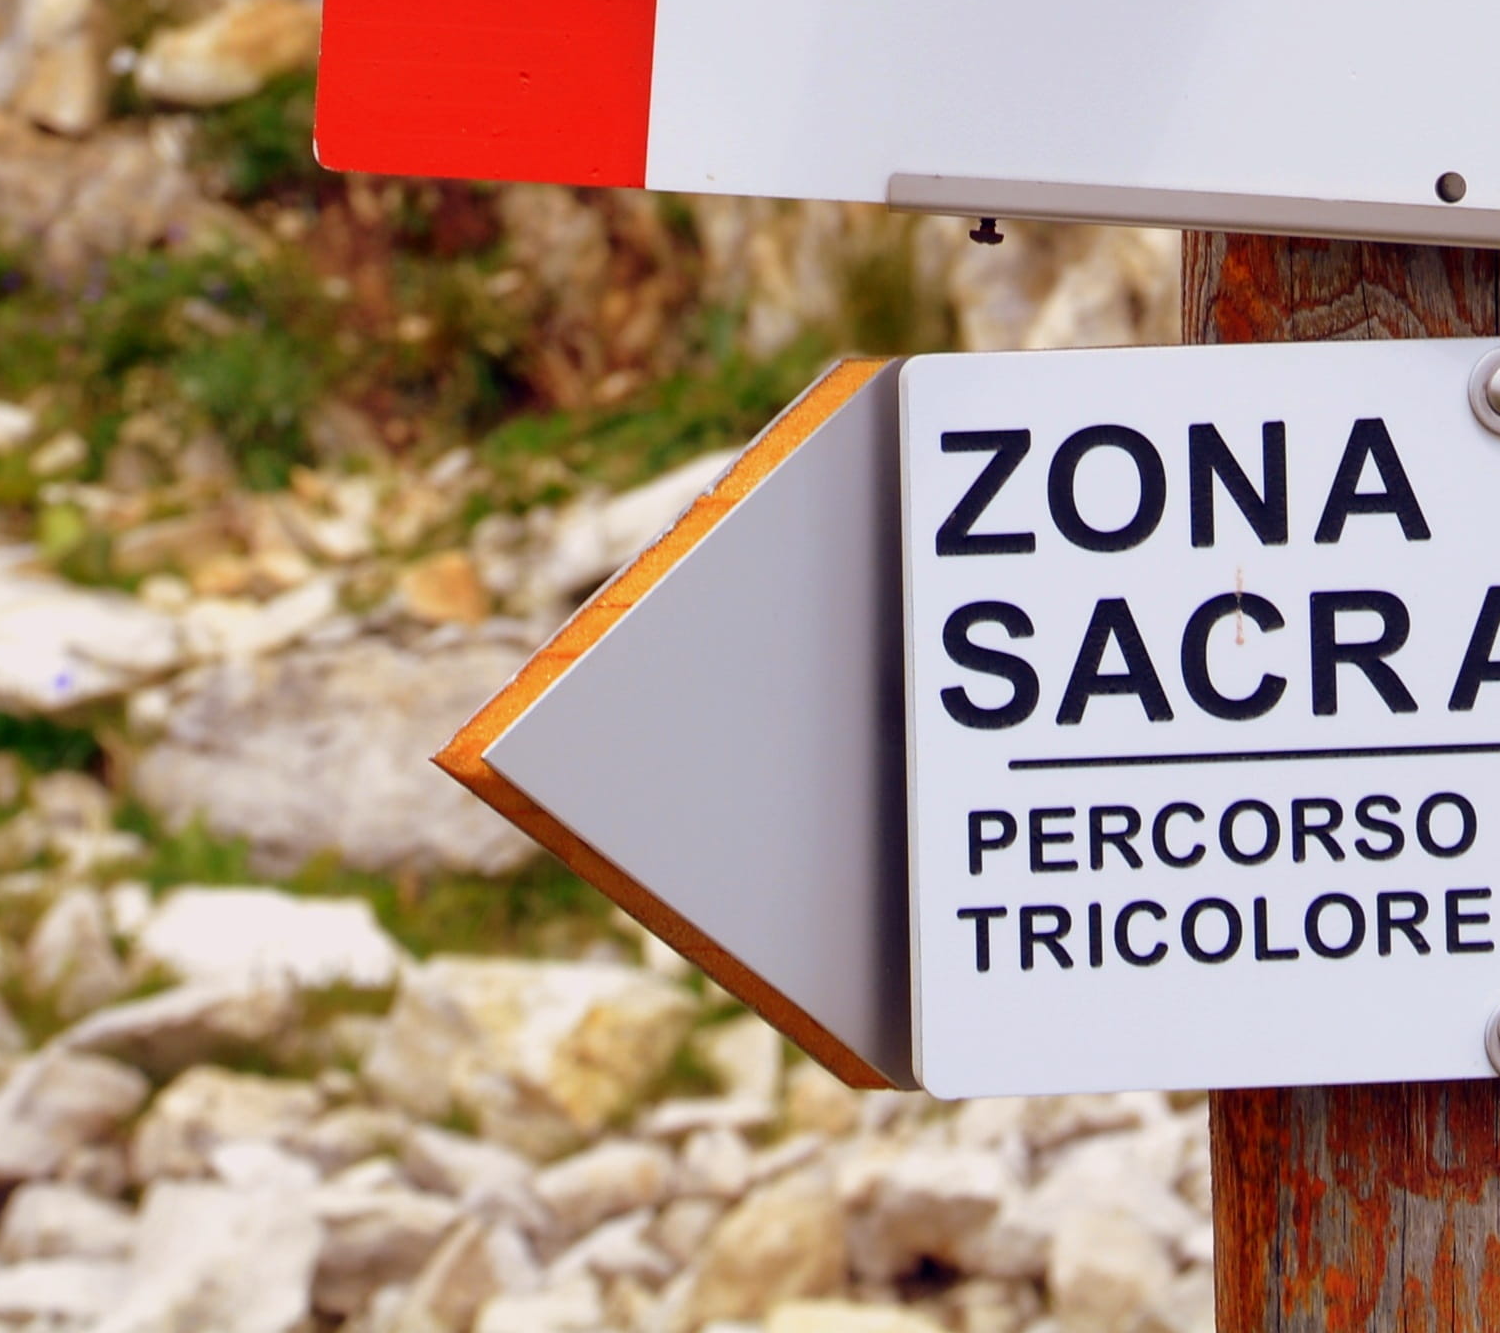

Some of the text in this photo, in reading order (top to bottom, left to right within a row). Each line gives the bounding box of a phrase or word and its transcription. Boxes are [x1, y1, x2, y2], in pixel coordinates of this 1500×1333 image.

[934, 416, 1433, 558] ZONA
[967, 791, 1478, 877] PERCORSO
[956, 887, 1496, 974] TRICOLORE
